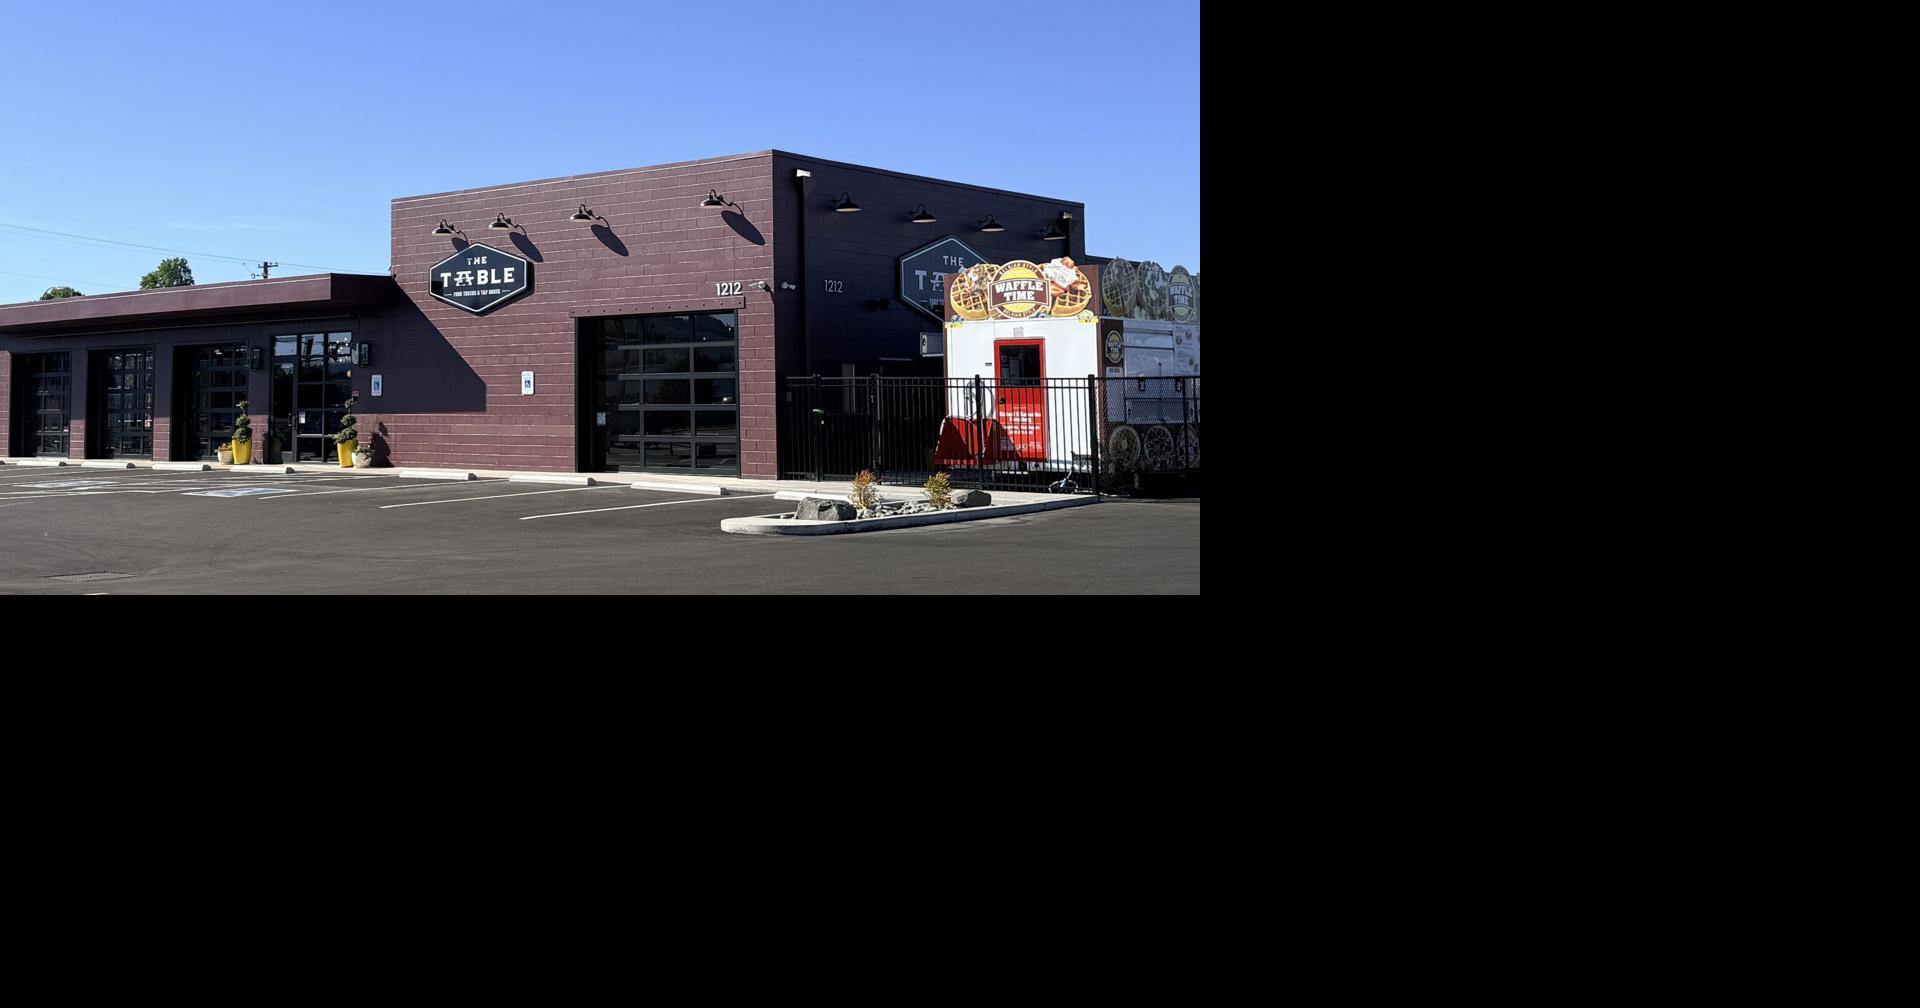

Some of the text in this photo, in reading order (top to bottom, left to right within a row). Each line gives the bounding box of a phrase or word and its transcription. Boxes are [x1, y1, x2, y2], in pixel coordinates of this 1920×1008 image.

[467, 256, 487, 265] THE
[943, 255, 964, 266] THE
[440, 267, 515, 287] TABLE
[716, 282, 742, 296] 1212
[824, 280, 843, 293] 1212
[995, 281, 1043, 293] WAFFLE
[1004, 291, 1034, 301] TIME
